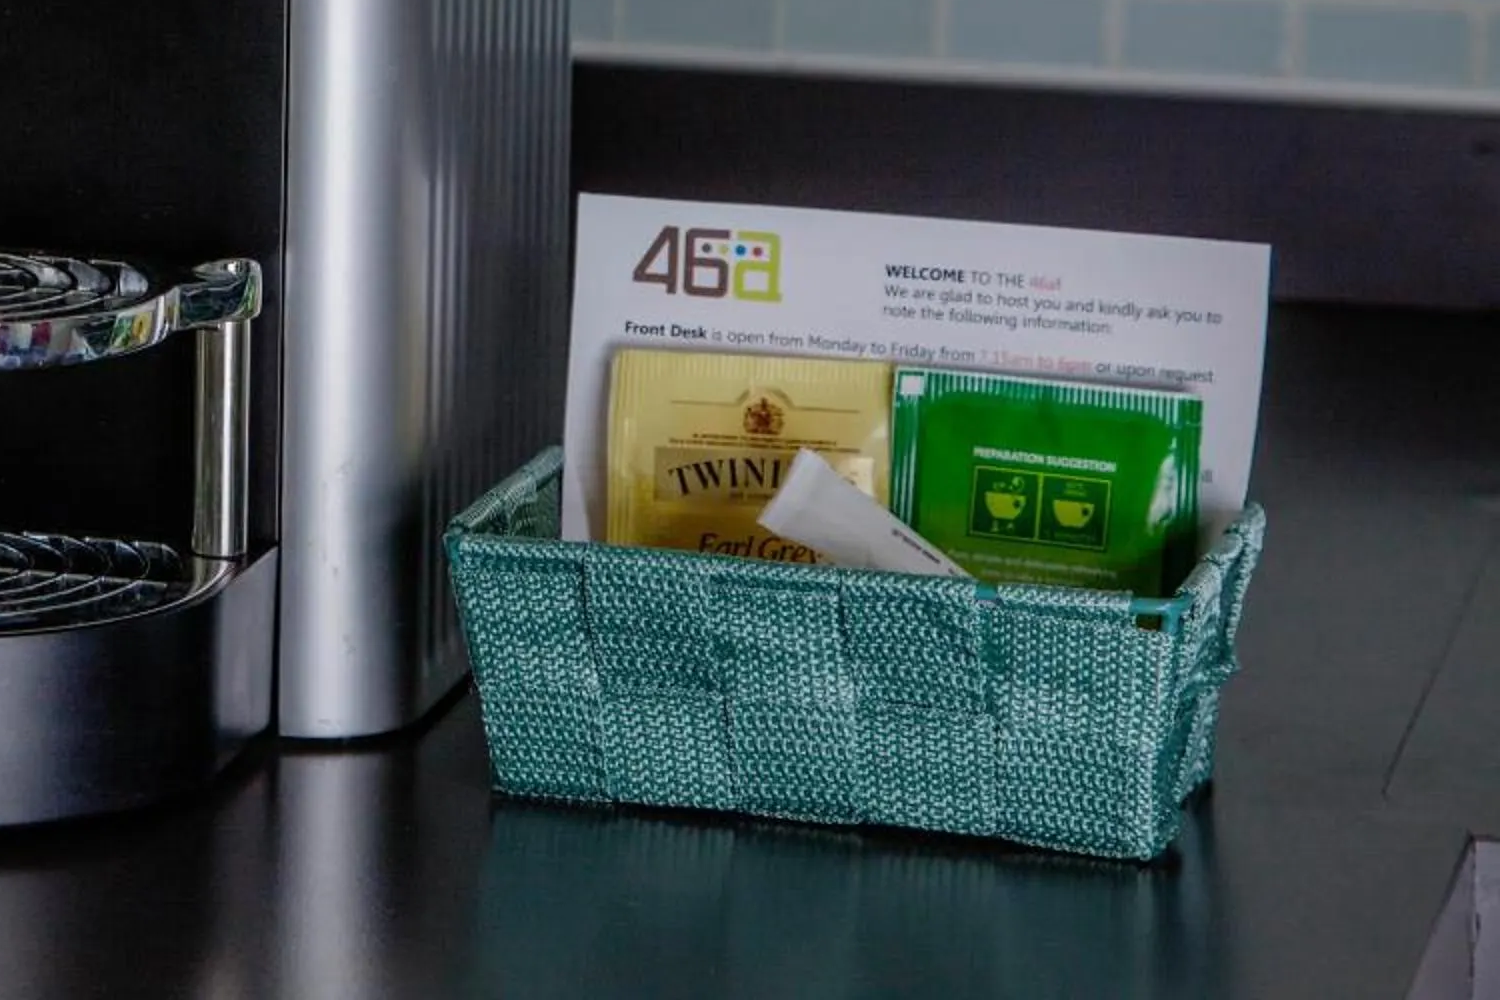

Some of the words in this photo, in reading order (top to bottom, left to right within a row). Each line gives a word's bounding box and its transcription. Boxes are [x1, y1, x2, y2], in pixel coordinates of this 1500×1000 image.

[632, 225, 783, 304] 46a
[885, 264, 964, 283] WELCOME
[971, 270, 992, 286] TO
[997, 272, 1026, 289] THE
[883, 305, 916, 319] note
[920, 306, 945, 321] the
[949, 308, 1018, 331] following
[885, 285, 908, 298] We
[912, 288, 935, 300] are
[939, 289, 973, 305] glad
[977, 291, 992, 305] to
[996, 293, 1029, 309] host
[1033, 298, 1061, 313] you
[1065, 300, 1095, 314] and
[1099, 301, 1143, 321] kindly
[1146, 305, 1171, 320] ask
[1175, 310, 1203, 326] you
[1207, 311, 1223, 325] to
[625, 320, 665, 336] Front
[670, 324, 707, 339] Desk
[711, 328, 722, 342] is
[726, 331, 765, 346] open
[769, 332, 803, 348] from
[807, 335, 867, 356] Monday
[870, 341, 887, 355] to
[891, 342, 935, 361] Friday
[939, 346, 975, 362] from
[1095, 362, 1111, 374] or
[1115, 363, 1155, 382] upon
[1159, 368, 1214, 385] request
[667, 456, 856, 497] TWINI
[699, 532, 754, 557] Earl
